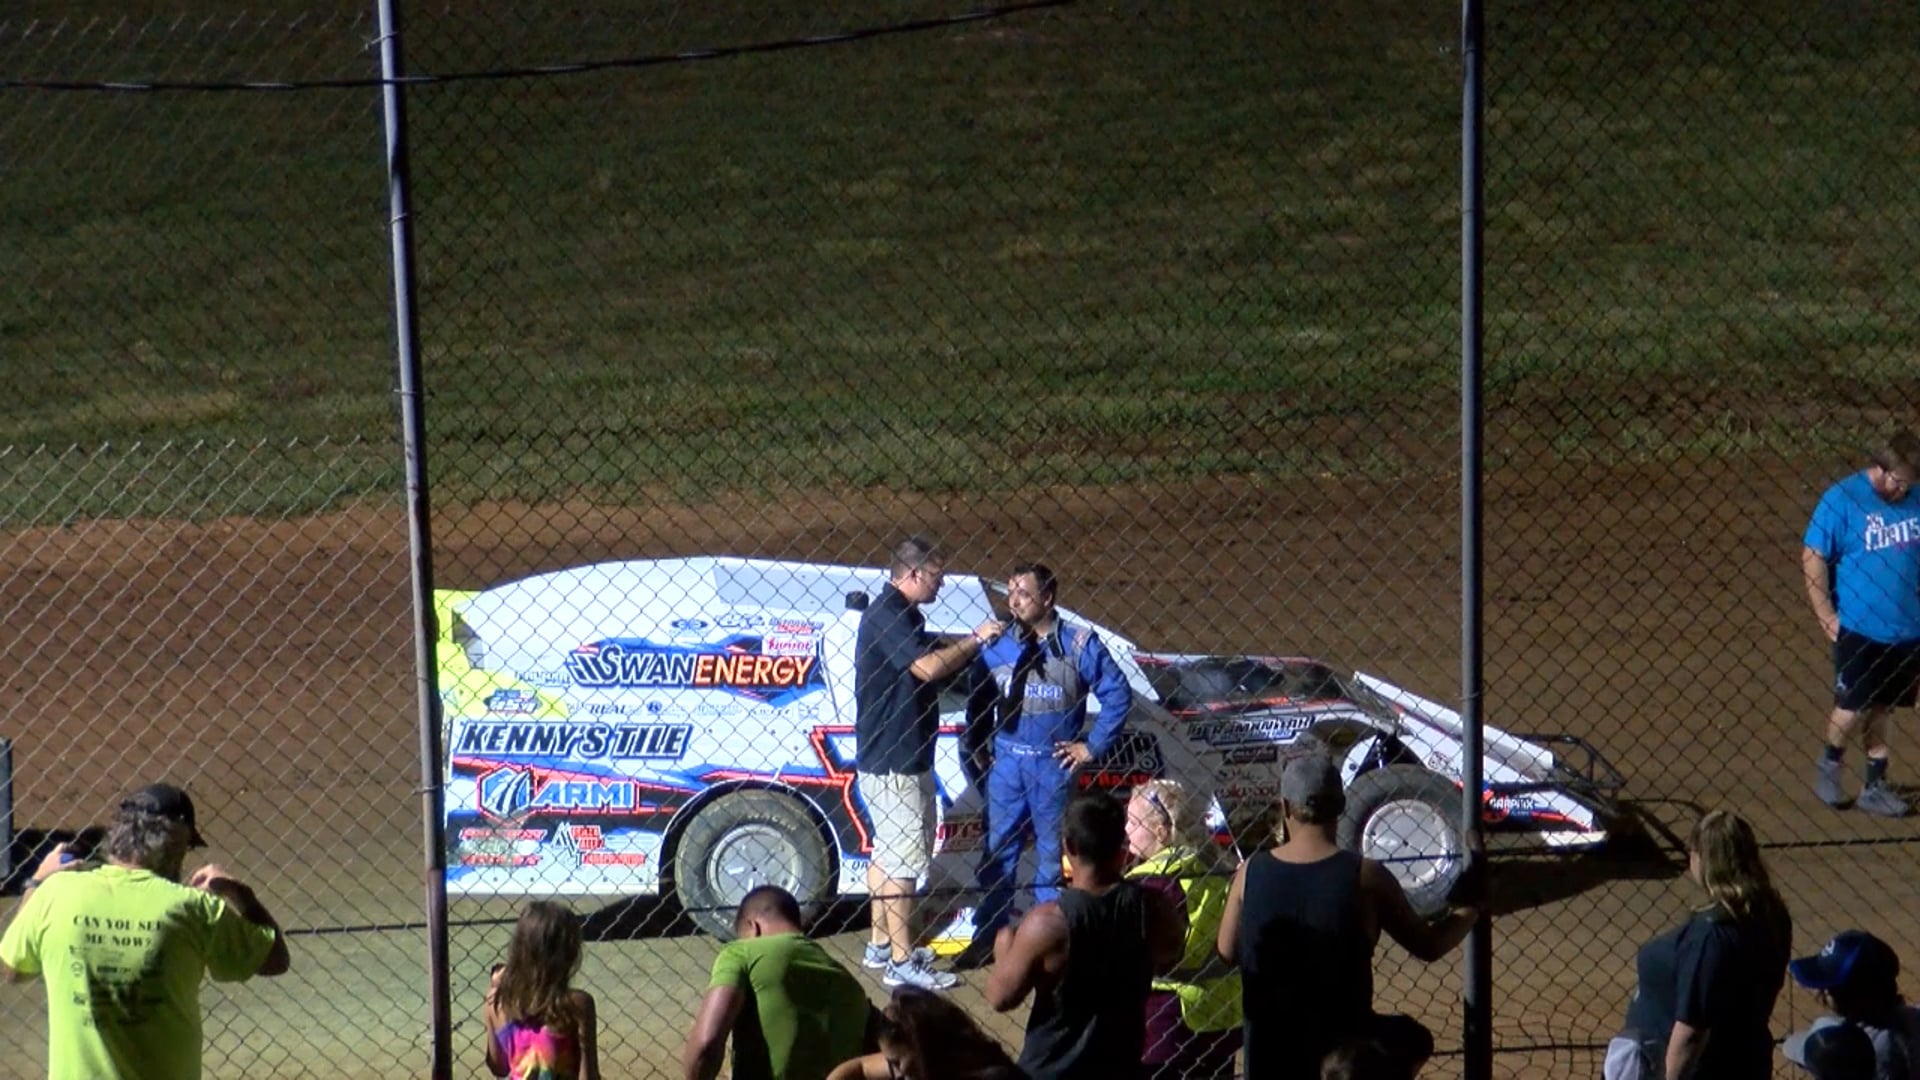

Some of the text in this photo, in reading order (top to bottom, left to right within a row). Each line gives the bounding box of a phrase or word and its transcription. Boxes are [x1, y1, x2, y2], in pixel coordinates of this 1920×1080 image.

[599, 645, 815, 686] SWAN ENERGY
[460, 723, 690, 757] KENNY'S TILE
[532, 780, 637, 809] ARMI
[73, 915, 100, 928] CAN
[106, 918, 131, 930] YOU
[86, 933, 152, 947] ME NOW?
